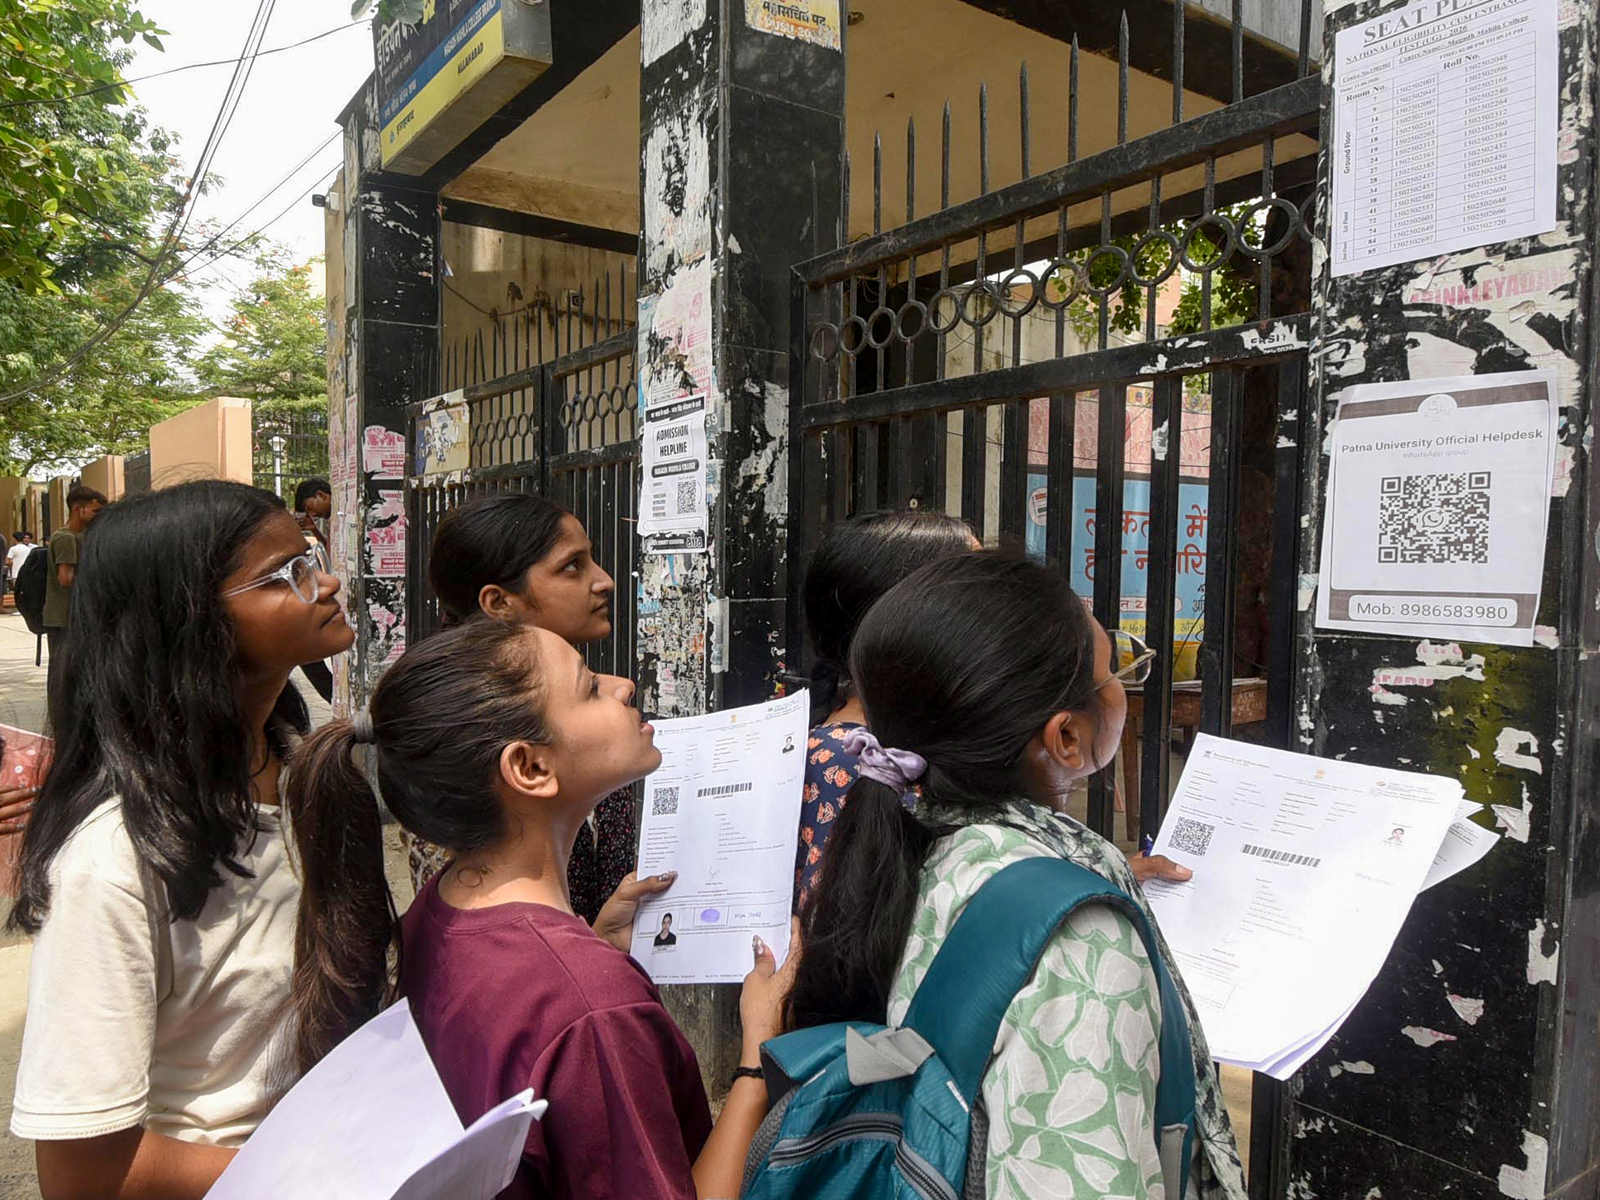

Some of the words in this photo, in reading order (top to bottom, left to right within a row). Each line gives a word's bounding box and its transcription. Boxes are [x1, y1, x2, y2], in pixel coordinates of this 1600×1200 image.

[1364, 6, 1428, 43] SEAT
[1436, 0, 1474, 17] PL
[1502, 13, 1528, 28] College
[1345, 43, 1387, 63] NATIONAL
[1450, 13, 1471, 26] CUM
[1400, 41, 1419, 53] TEST
[1449, 24, 1467, 35] 2026
[1443, 57, 1461, 70] Roll
[1464, 51, 1480, 63] No.
[1346, 88, 1369, 102] Room
[1372, 82, 1386, 93] No.
[656, 424, 689, 441] ADMISSION
[1341, 444, 1372, 454] Patna
[1375, 438, 1432, 451] University
[1435, 433, 1479, 446] Official
[1482, 428, 1543, 444] Helpdesk
[660, 441, 687, 457] HELPLINE
[1403, 450, 1444, 460] WhatsApp
[1445, 450, 1469, 459] group
[1356, 602, 1395, 616] Mob:
[1400, 603, 1508, 620] 8986583980
